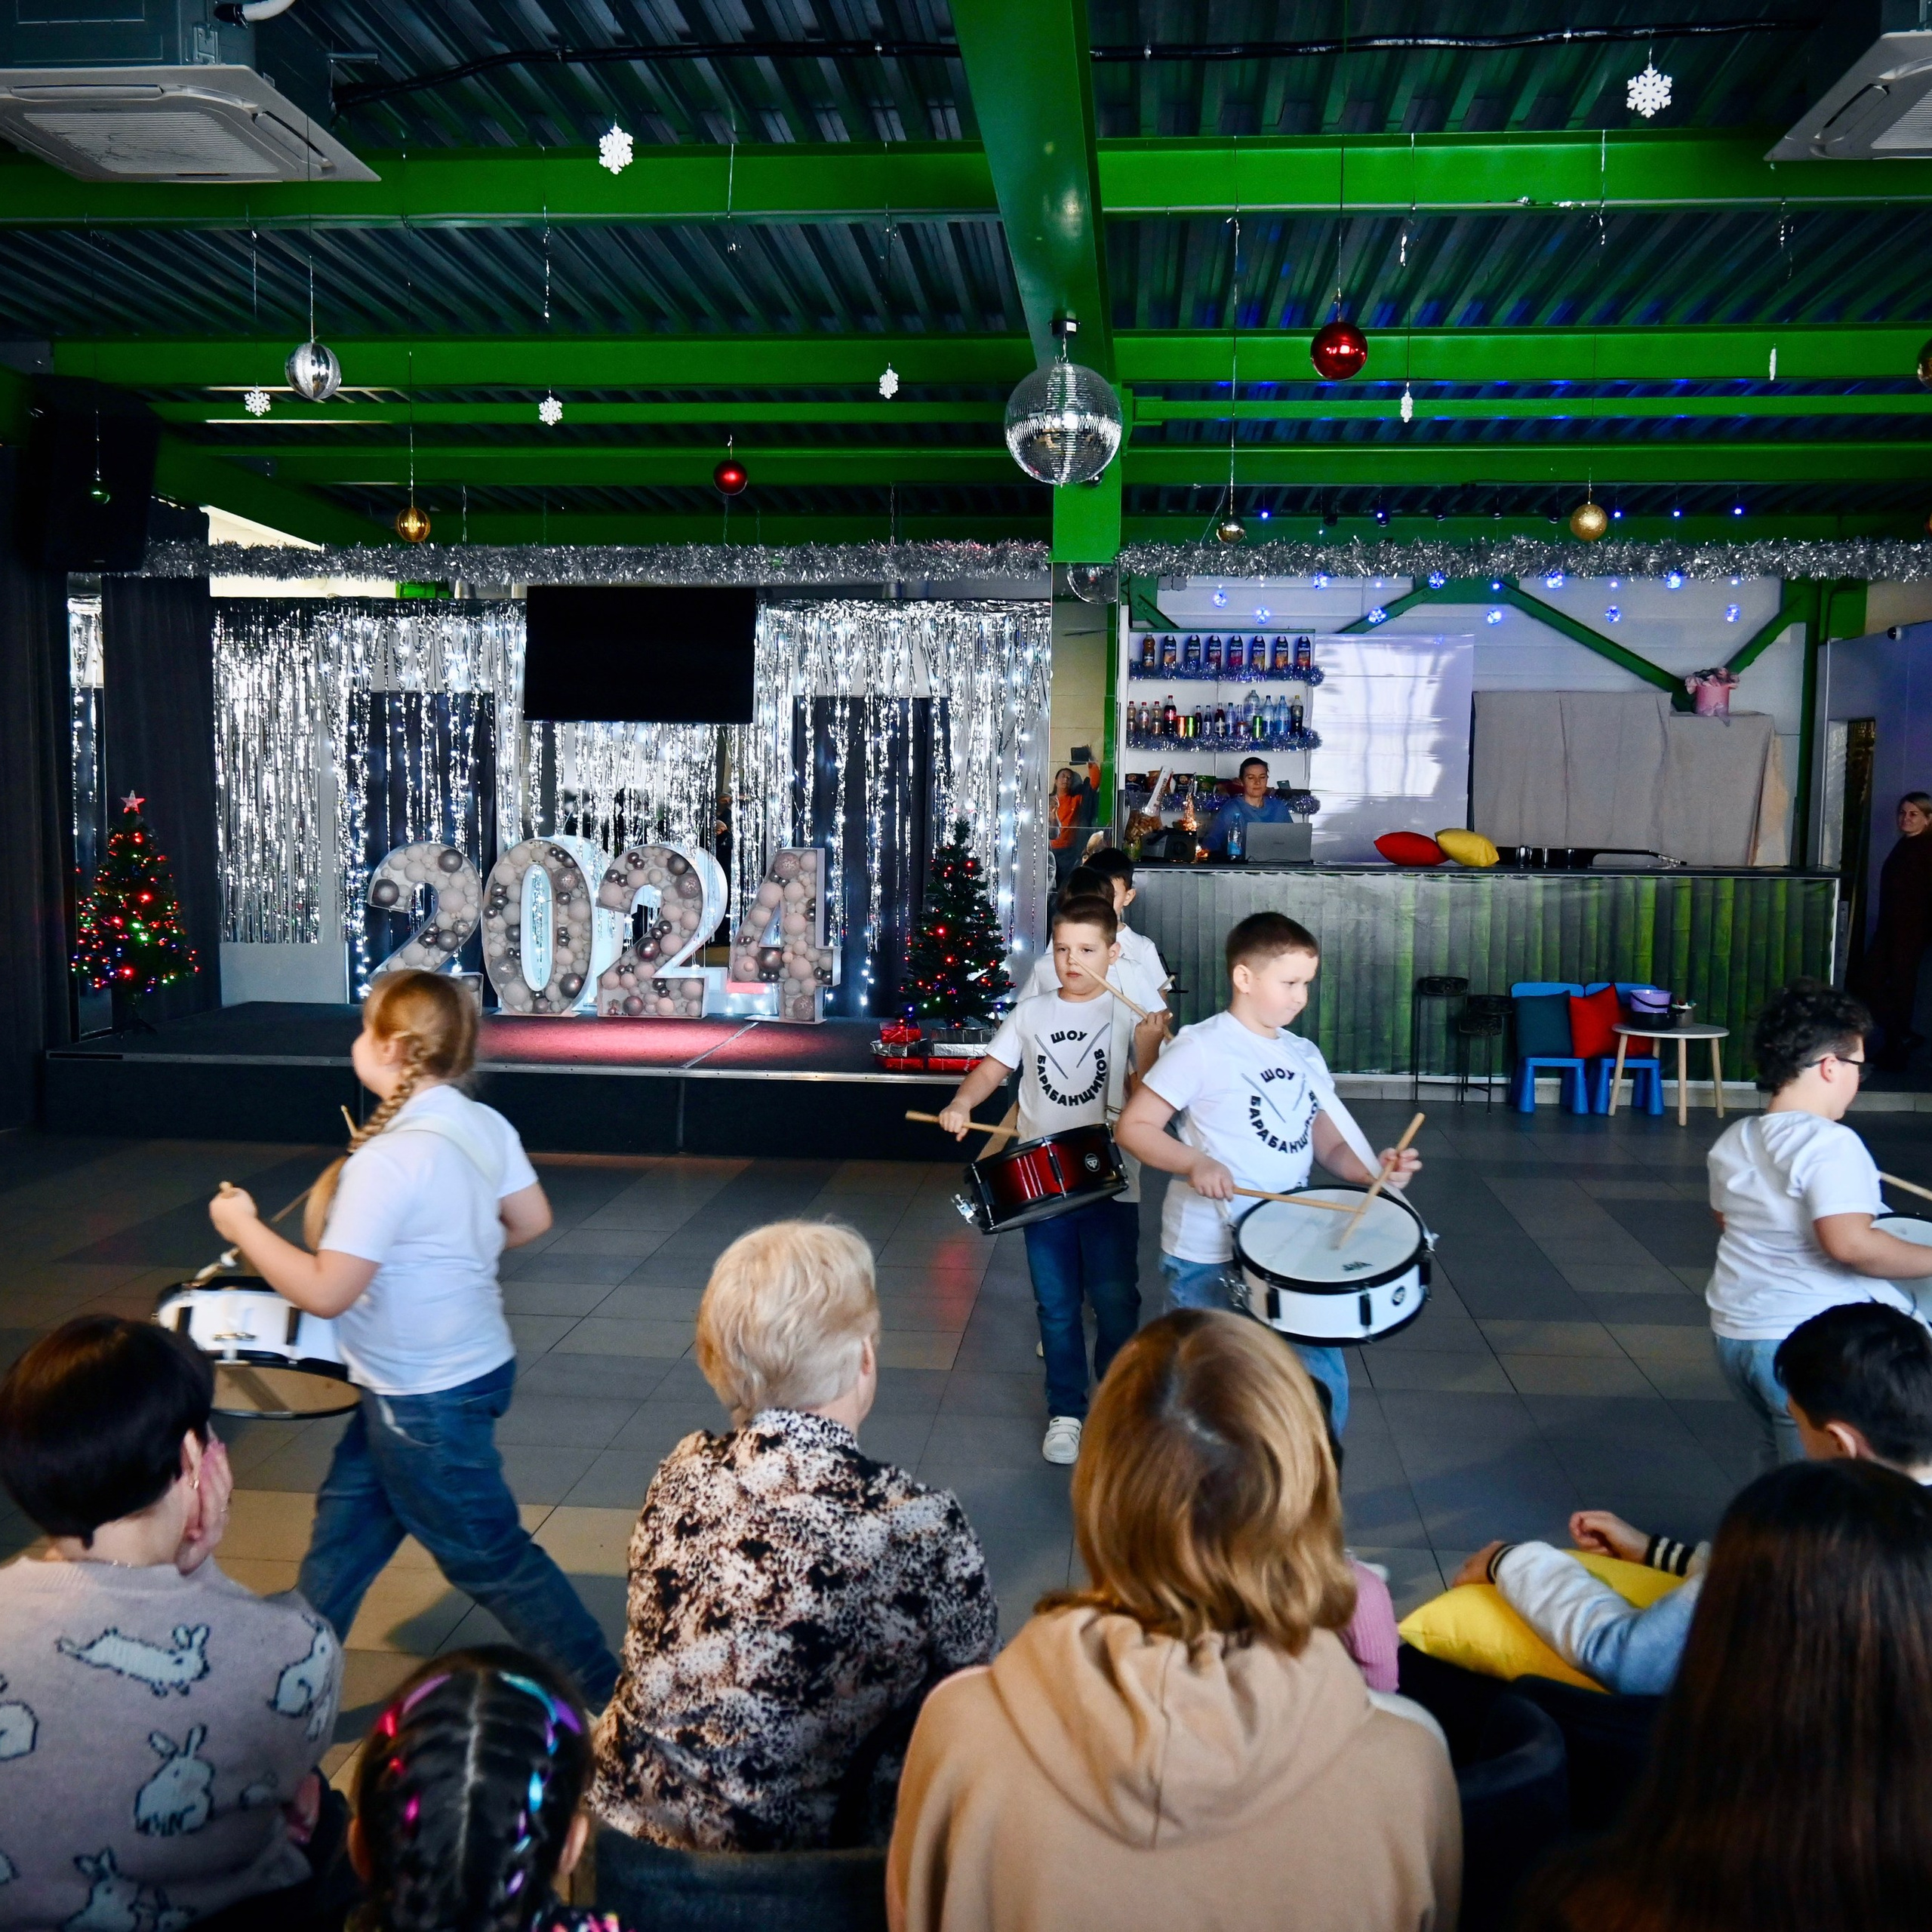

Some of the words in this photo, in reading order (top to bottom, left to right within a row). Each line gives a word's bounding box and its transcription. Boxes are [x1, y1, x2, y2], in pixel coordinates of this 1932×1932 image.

[368, 835, 841, 1024] 2024
[1050, 1030, 1088, 1044] ШОУ
[1037, 1048, 1107, 1107] БАРАБАНЩИКОВ
[1260, 1067, 1296, 1084] ШОУ
